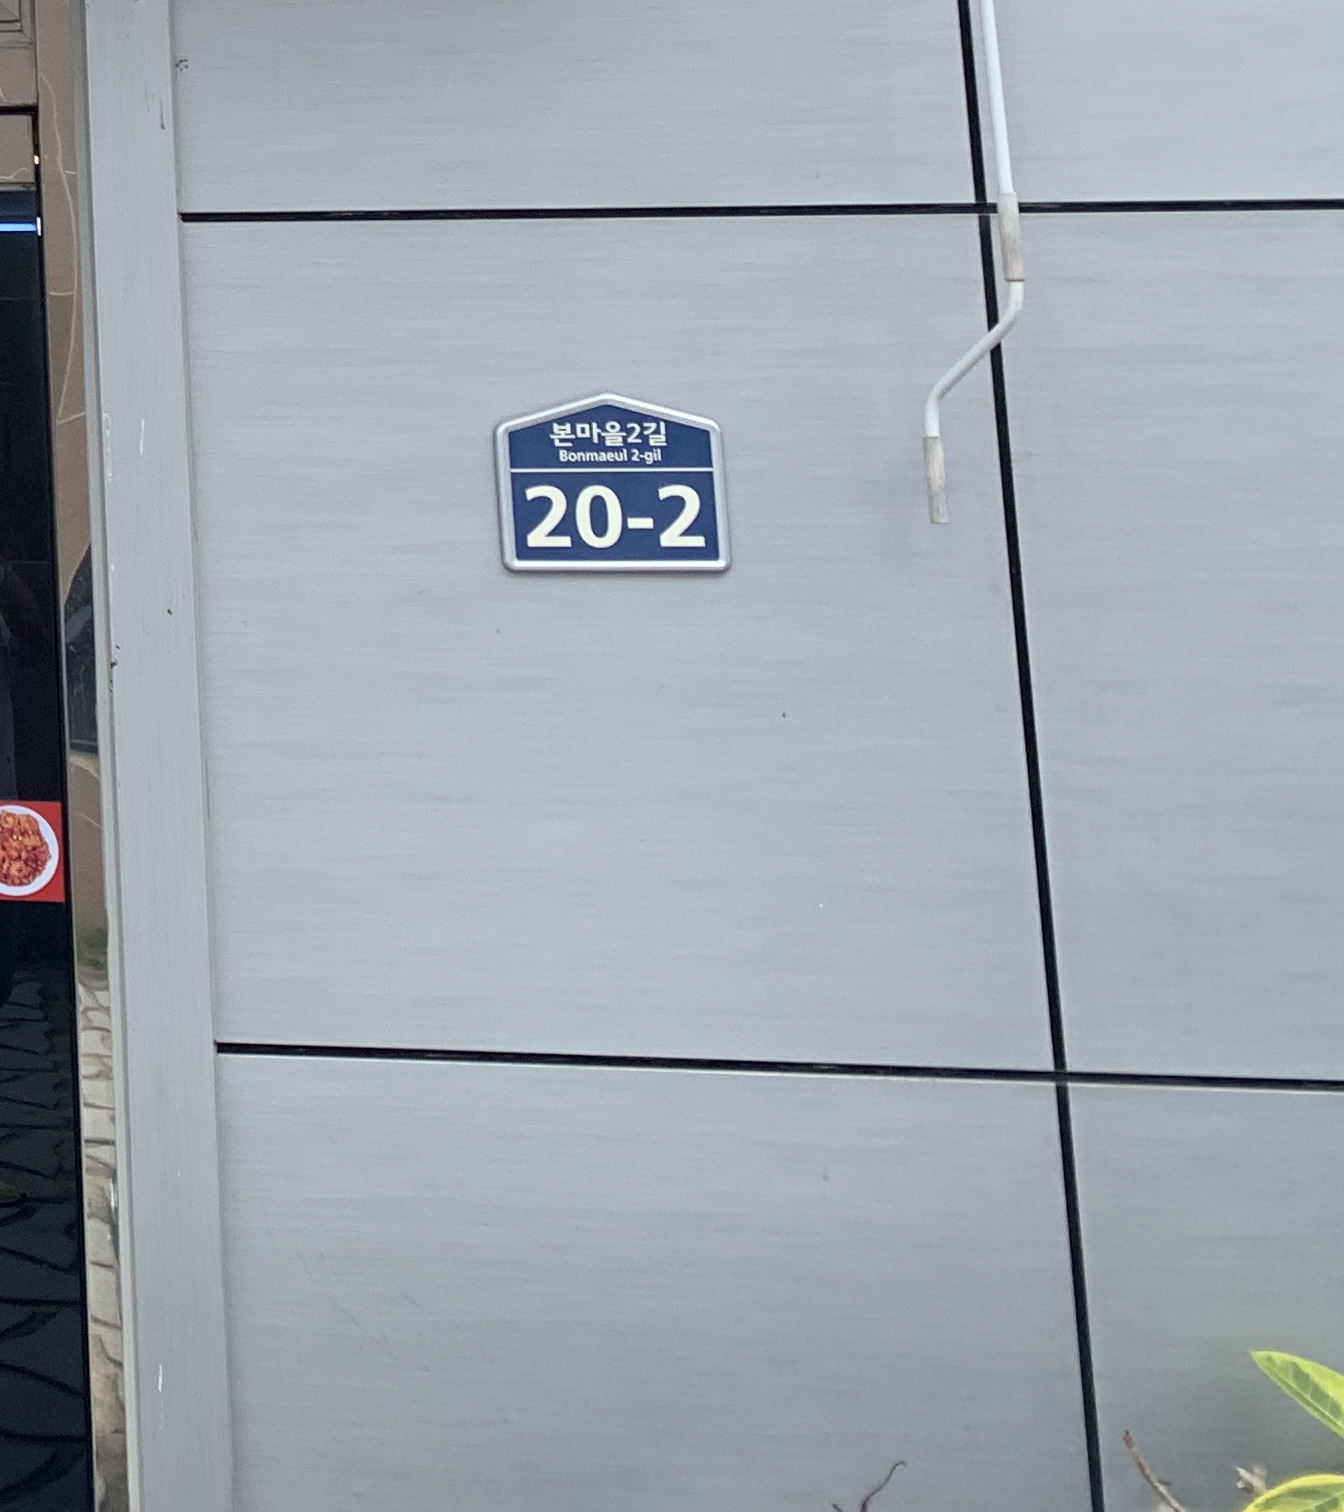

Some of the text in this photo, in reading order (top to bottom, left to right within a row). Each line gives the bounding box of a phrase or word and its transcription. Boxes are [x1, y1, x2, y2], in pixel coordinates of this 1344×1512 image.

[549, 421, 667, 447] 본마을2길
[559, 448, 662, 465] Bonmaeul 2-gil
[524, 484, 706, 549] 20-2
